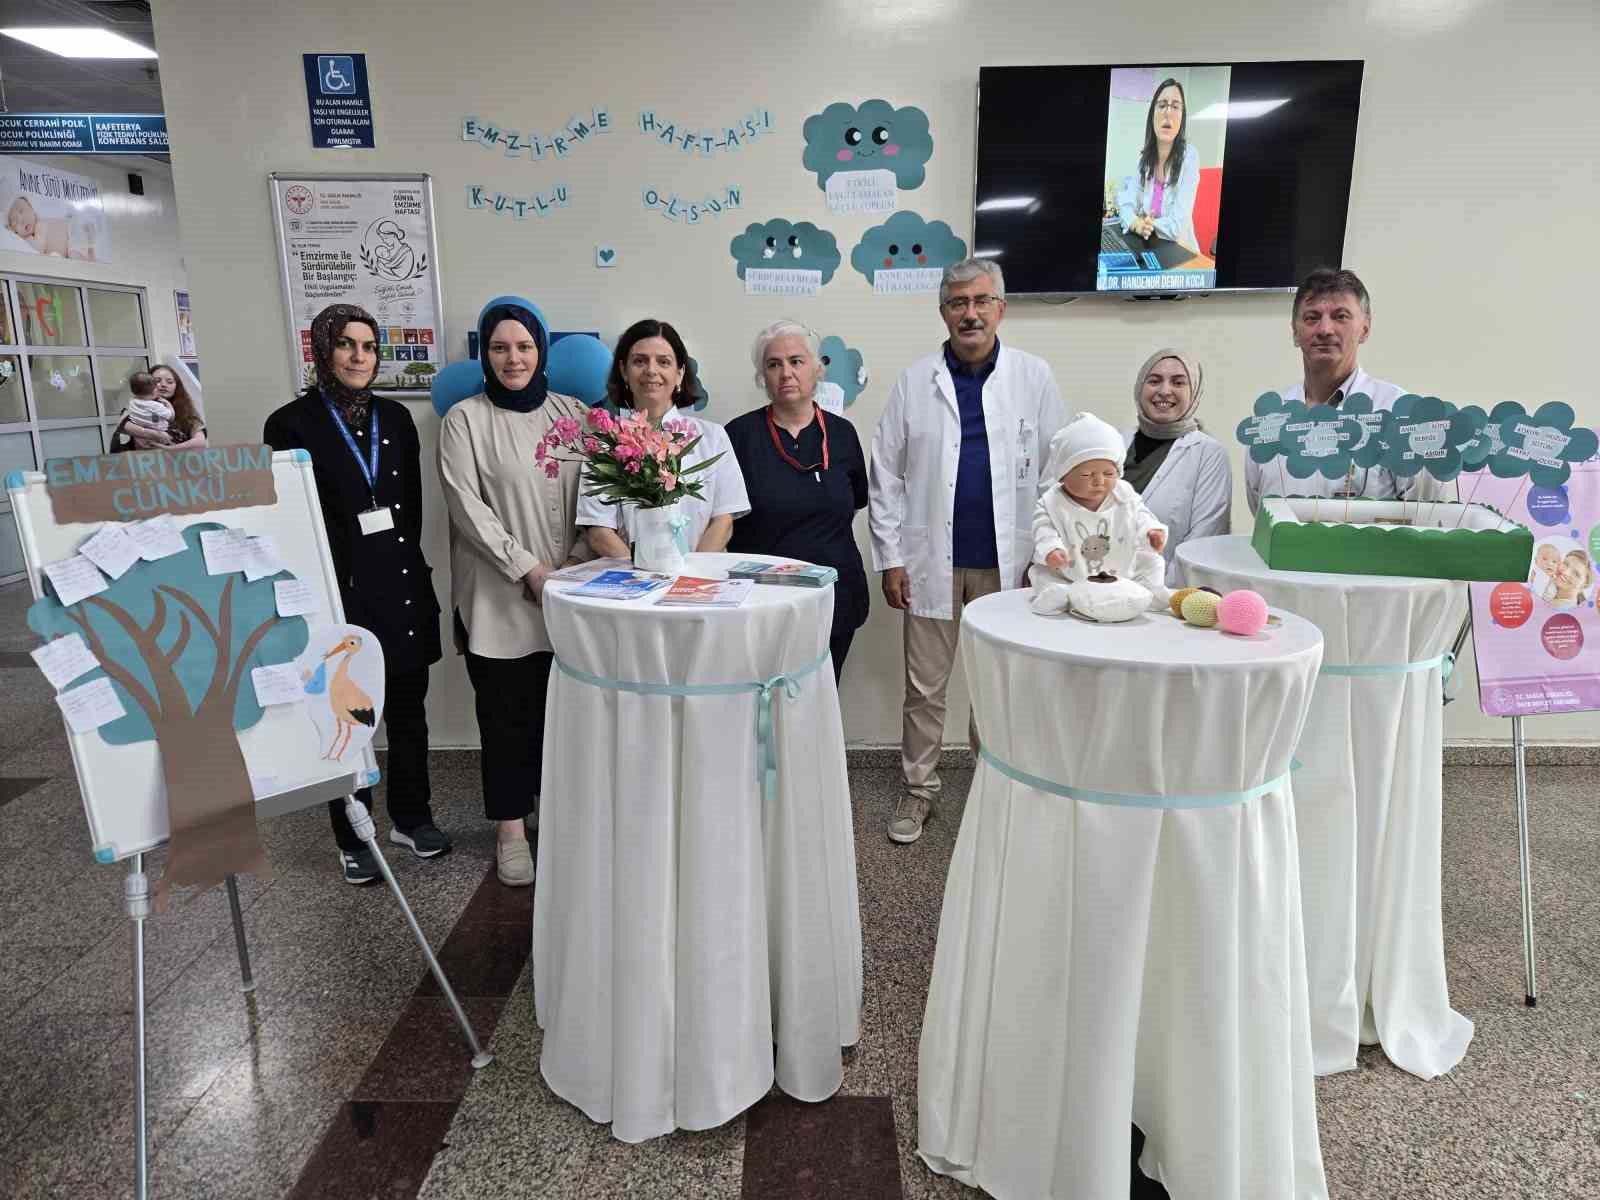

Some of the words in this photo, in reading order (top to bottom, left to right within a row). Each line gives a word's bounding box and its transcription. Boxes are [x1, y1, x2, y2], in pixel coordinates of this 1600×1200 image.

[24, 118, 60, 128] CERRAHİ
[96, 123, 142, 131] KAFETERYA
[341, 250, 352, 261] ile
[301, 261, 356, 272] Sürdürülebilir
